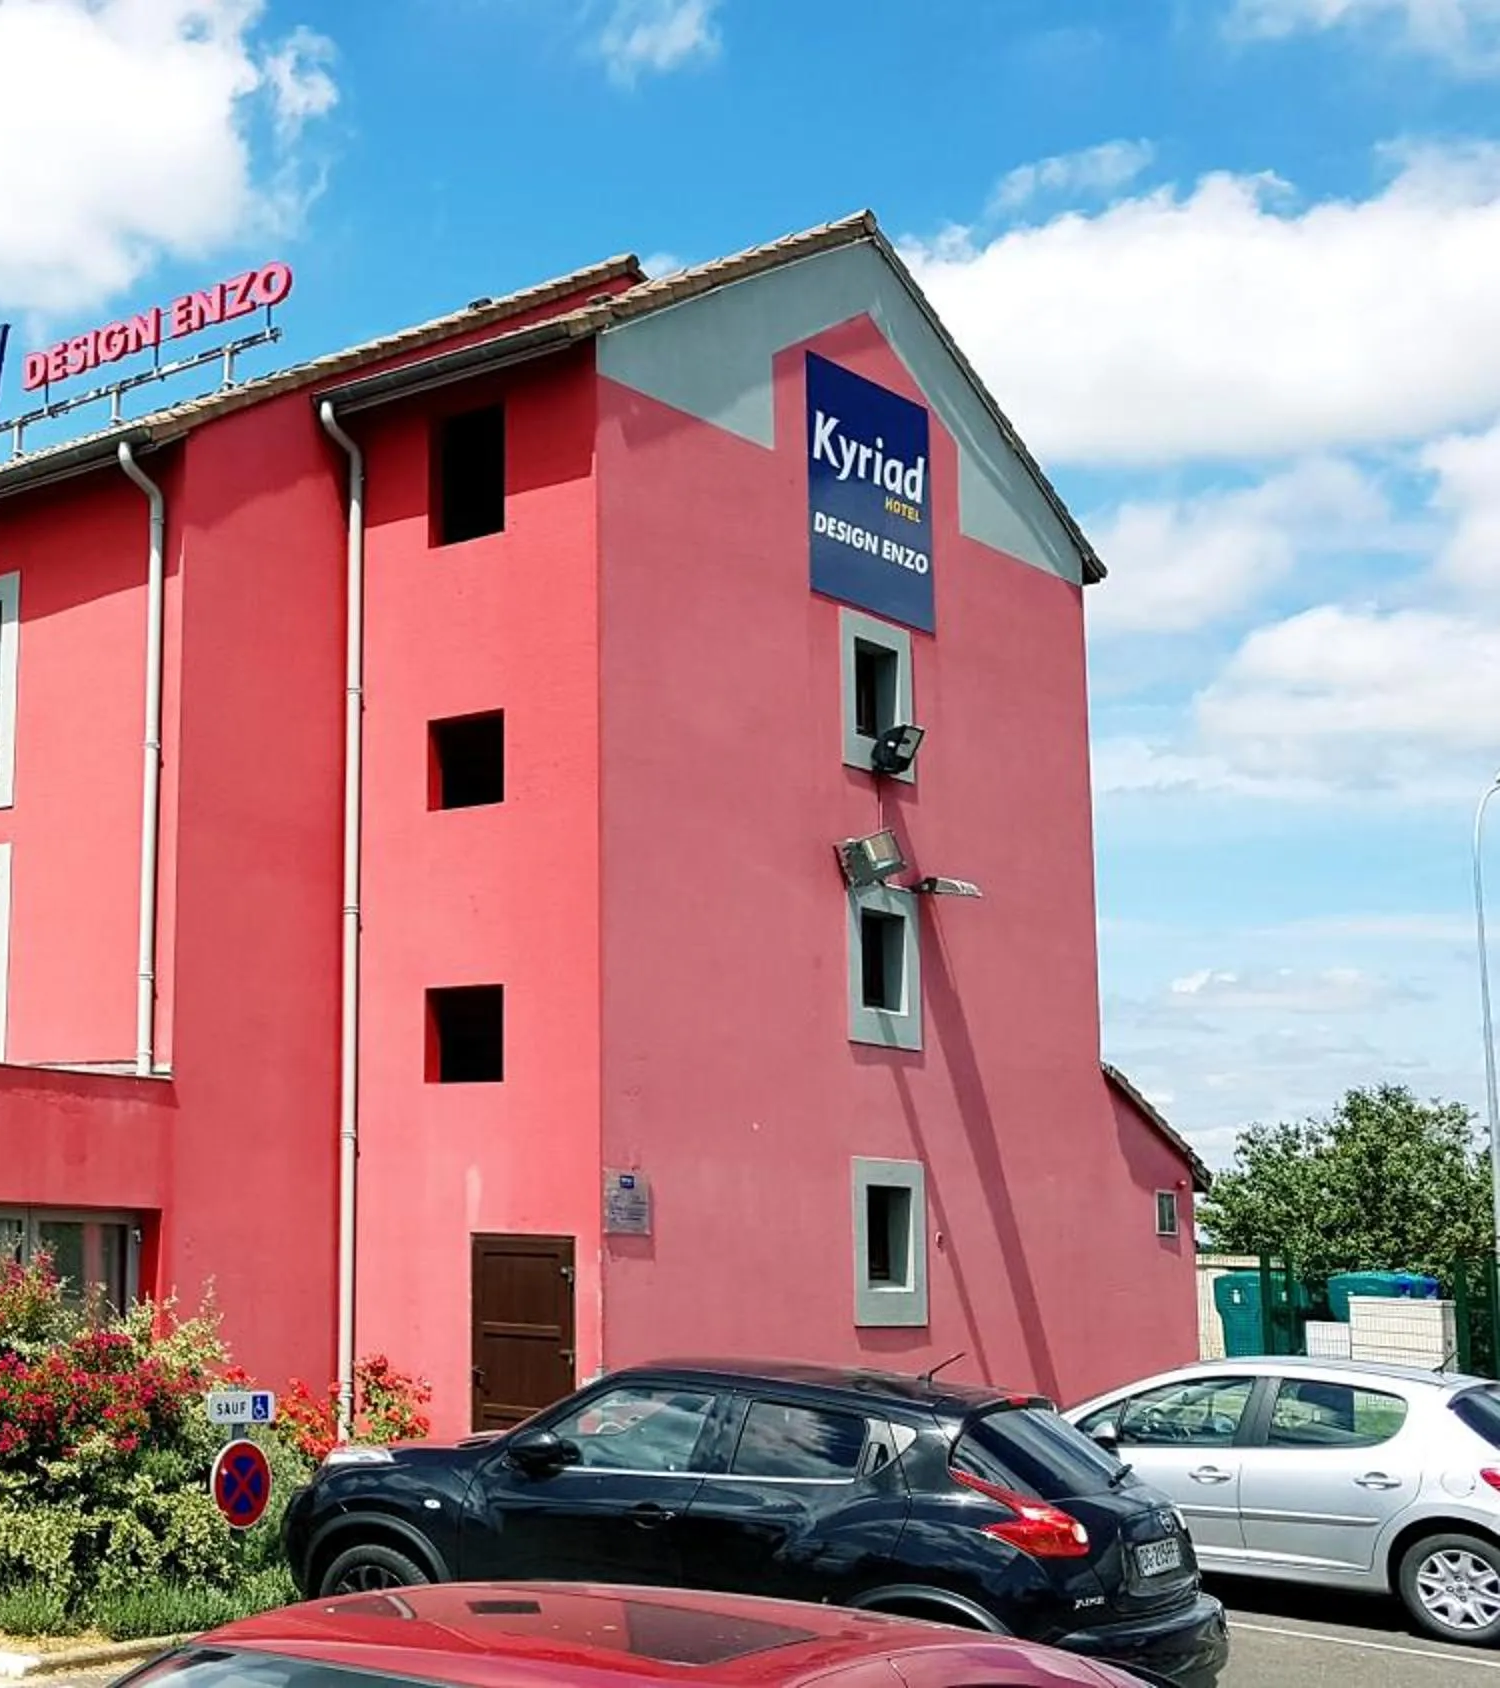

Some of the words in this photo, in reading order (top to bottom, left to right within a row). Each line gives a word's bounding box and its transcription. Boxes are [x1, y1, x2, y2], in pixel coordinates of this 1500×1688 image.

[22, 307, 162, 392] DESIGN
[171, 260, 293, 340] ENZO
[813, 410, 925, 504] Kyriad
[884, 496, 921, 523] HOTEL
[814, 511, 879, 555] DESIGN
[882, 539, 929, 574] ENZO
[216, 1401, 246, 1416] SAUF
